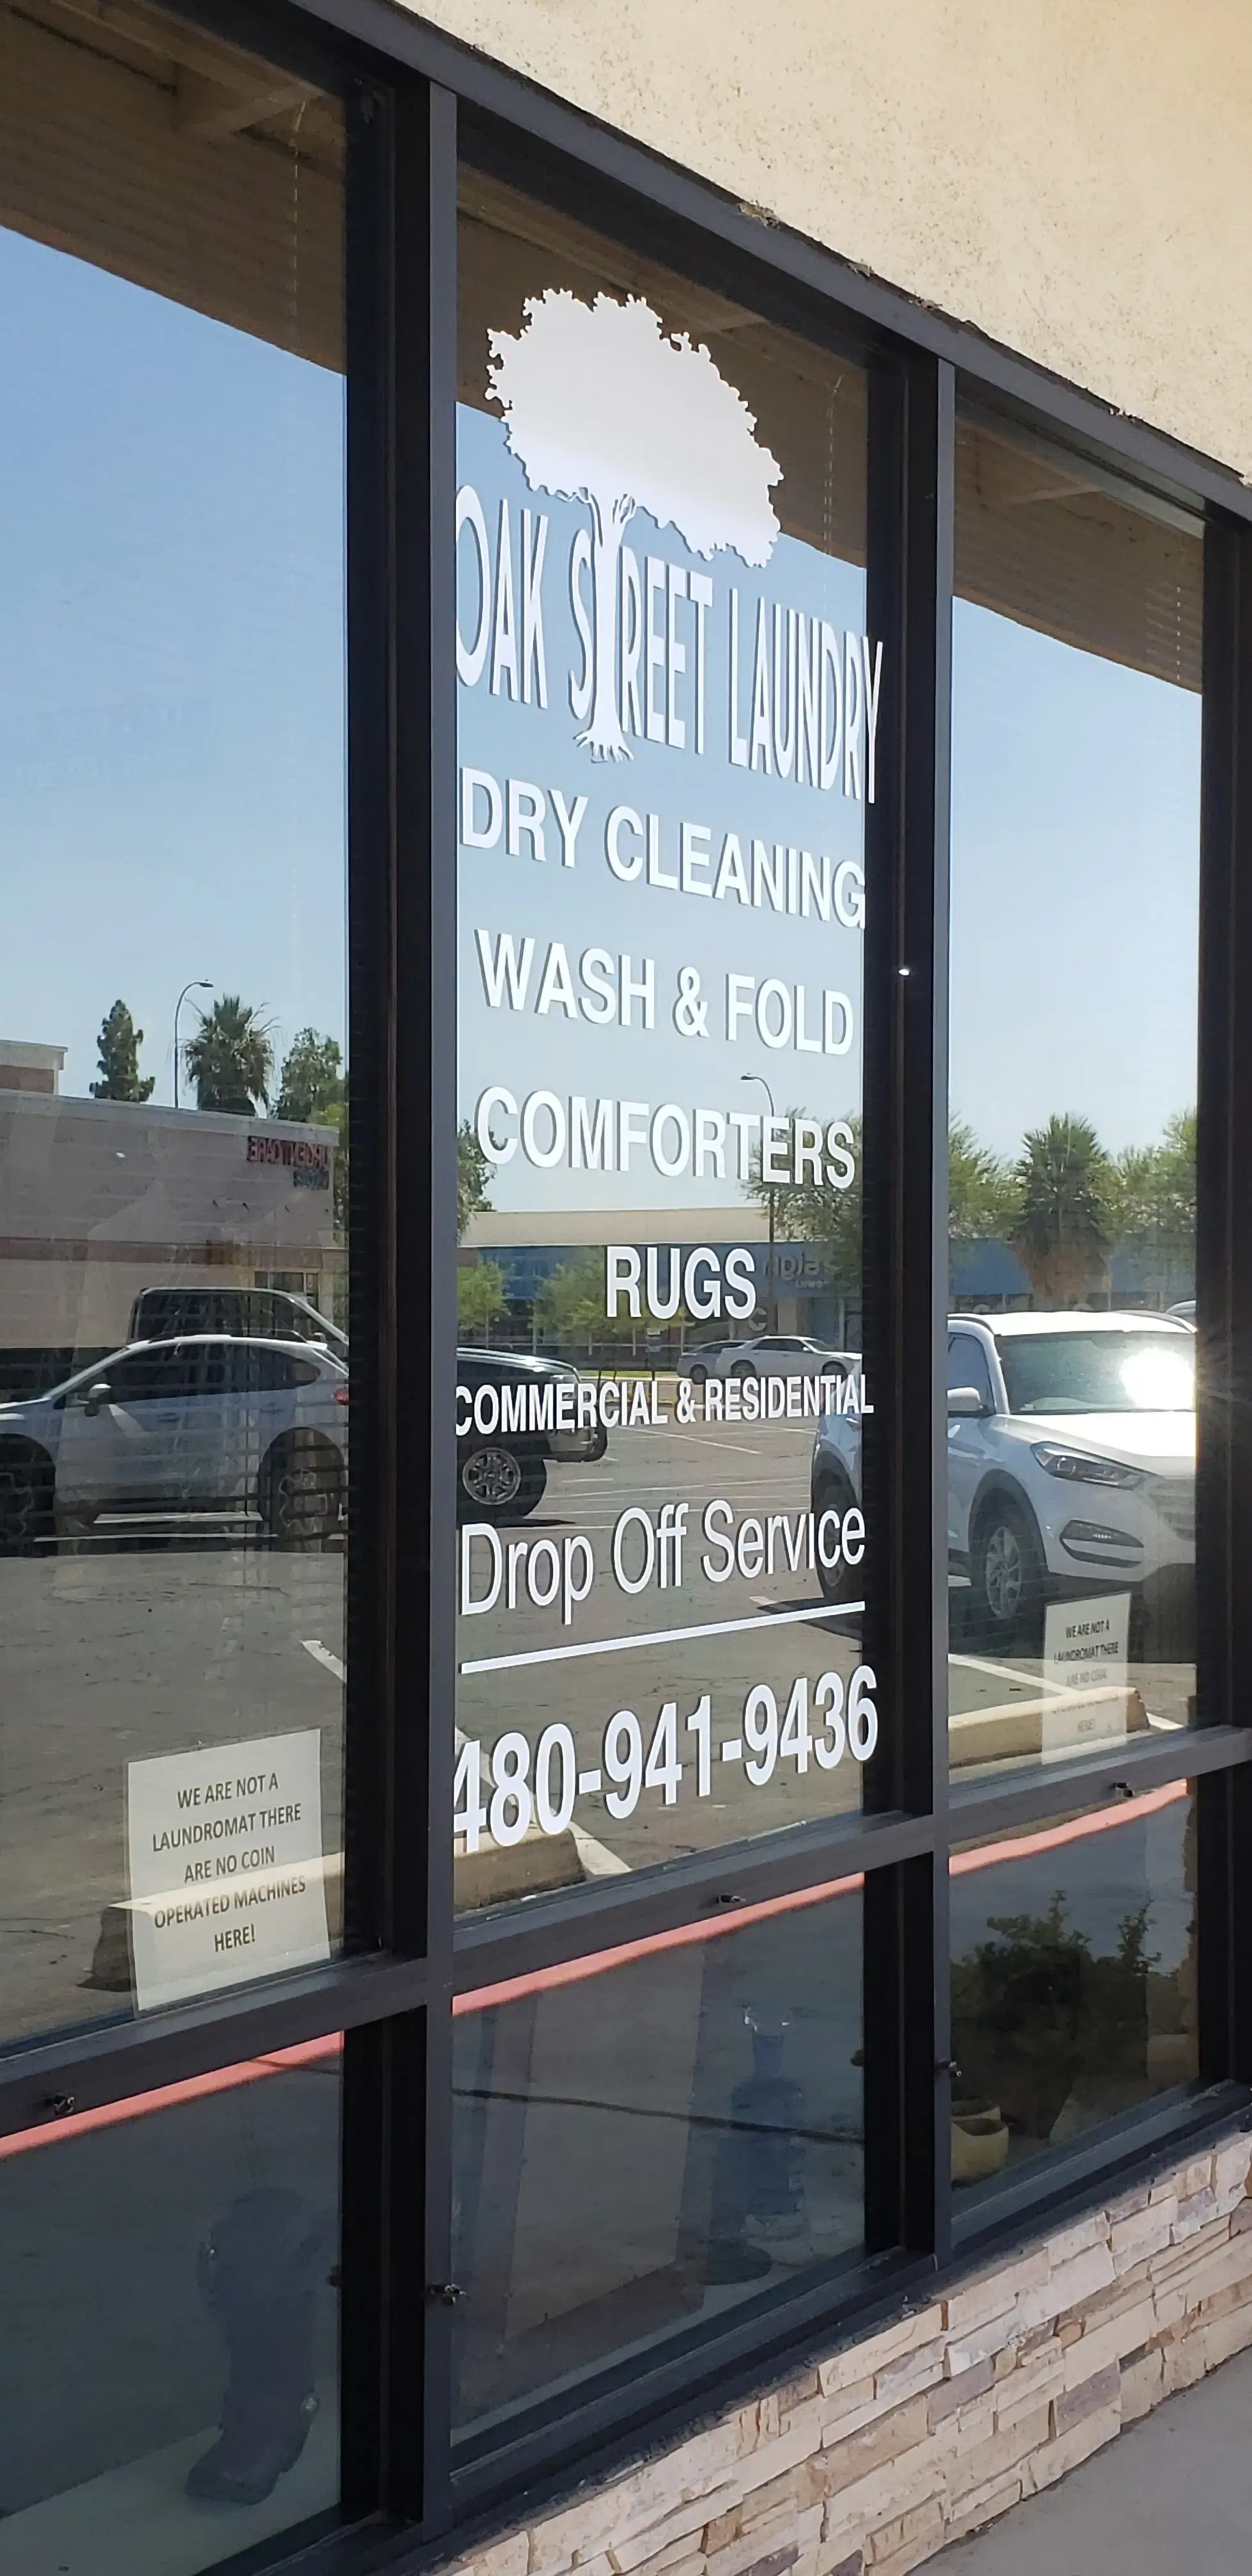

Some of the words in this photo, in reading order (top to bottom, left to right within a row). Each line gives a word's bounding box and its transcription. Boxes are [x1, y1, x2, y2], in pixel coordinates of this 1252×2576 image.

[456, 485, 547, 710] OAK
[729, 588, 883, 804] LAUNDRY
[461, 767, 588, 868] DRY
[605, 806, 866, 930] CLEANING
[474, 928, 655, 1029] WASH
[672, 966, 708, 1038] &
[725, 973, 853, 1055] FOLD
[475, 1085, 855, 1189] COMFORTERS
[606, 1245, 756, 1319] RUGS
[456, 1381, 668, 1436] COMMERCIAL
[676, 1380, 696, 1423] &
[705, 1374, 874, 1422] RESIDENTIAL
[461, 1522, 594, 1625] Drop
[614, 1502, 689, 1594] Off
[702, 1499, 866, 1583] Service
[178, 1788, 201, 1809] WE
[204, 1781, 232, 1804] ARE
[236, 1774, 266, 1798] NOT
[268, 1772, 279, 1790] A
[454, 1665, 878, 1853] 480-941-9436
[153, 1812, 256, 1852] LAUNDROMAT
[259, 1803, 302, 1828] THERE
[184, 1860, 212, 1883] ARE
[216, 1857, 237, 1876] NO
[241, 1846, 275, 1869] COIN
[154, 1894, 229, 1929] OPERATED
[234, 1875, 306, 1909] MACHINES
[214, 1923, 256, 1952] HERE!
